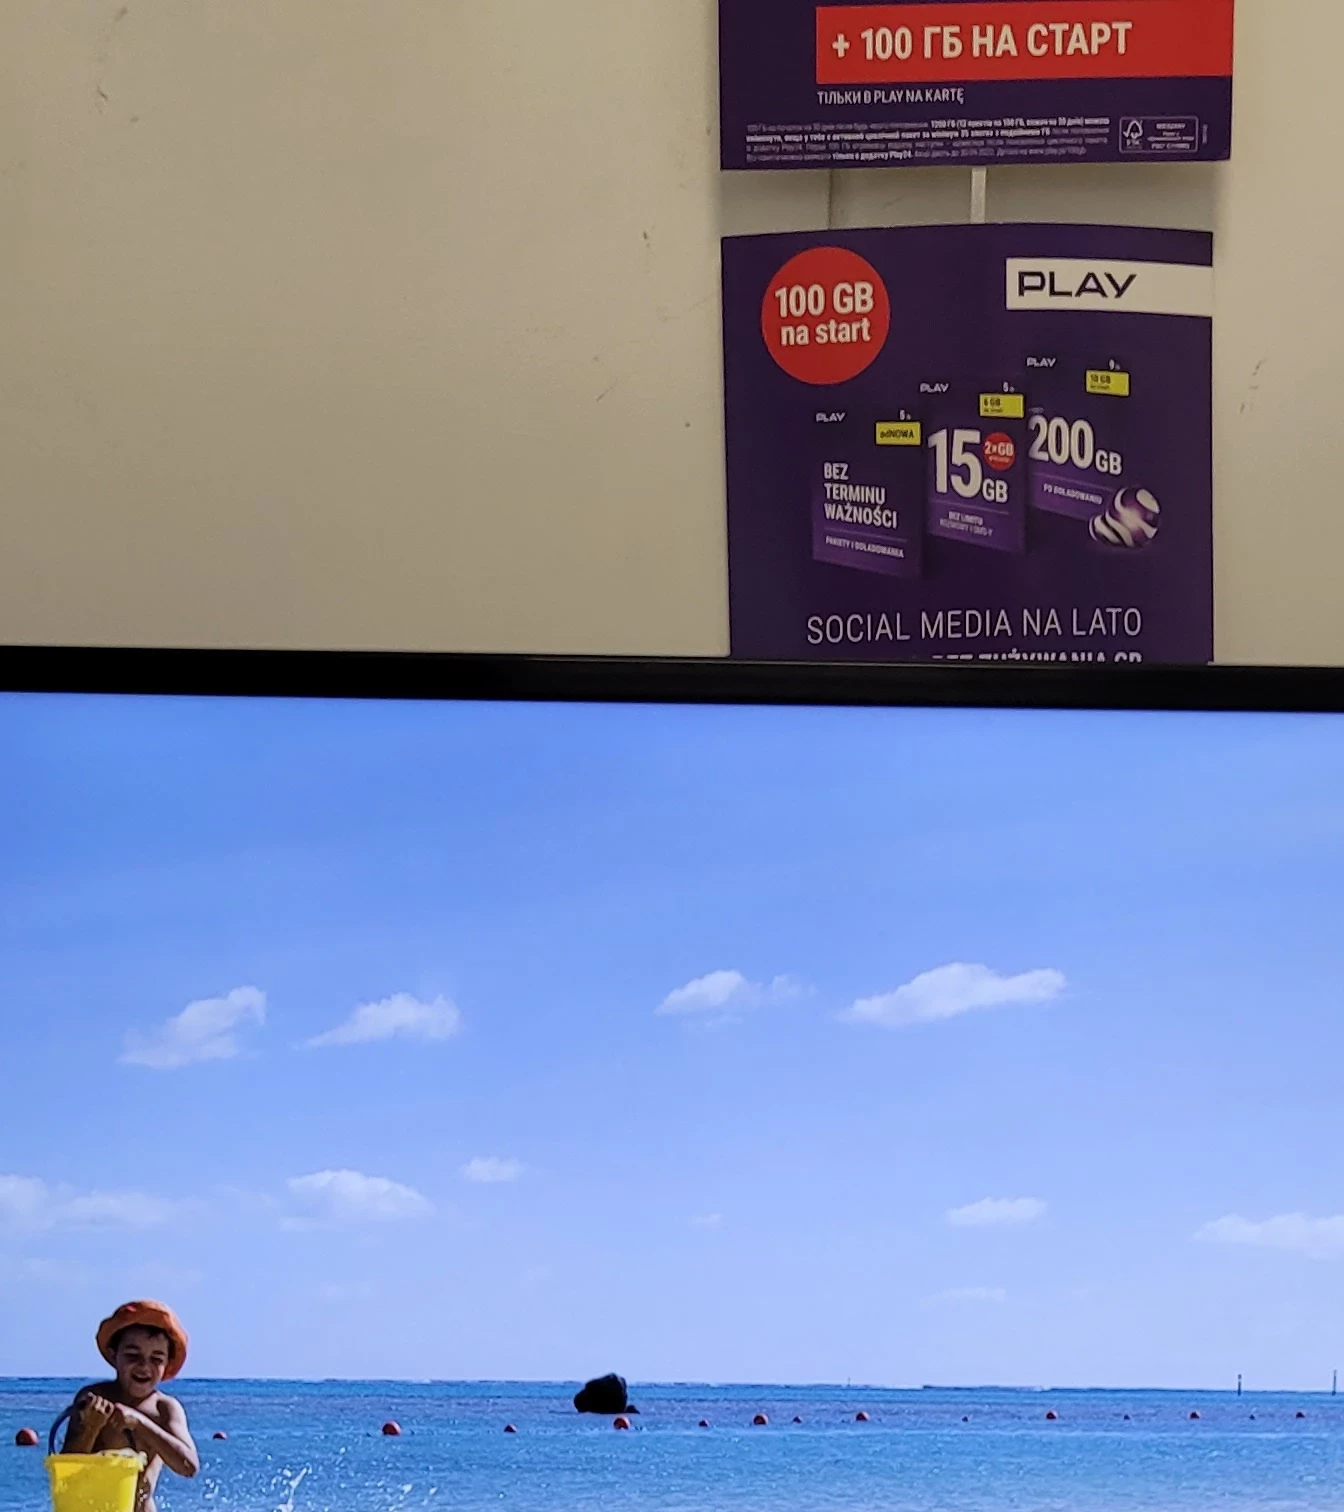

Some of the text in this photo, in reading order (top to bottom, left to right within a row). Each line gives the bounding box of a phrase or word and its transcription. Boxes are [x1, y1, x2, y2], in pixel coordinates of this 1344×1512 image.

[860, 26, 913, 60] 100
[923, 25, 963, 59] ГБ
[972, 23, 1017, 57] НА
[1027, 21, 1133, 56] СТАРТ
[873, 89, 904, 104] PLAY
[906, 88, 924, 103] NA
[925, 87, 965, 104] KARTĘ
[1017, 270, 1137, 299] PLAY
[774, 280, 874, 318] 100 GB
[780, 316, 872, 346] na start
[1027, 356, 1056, 367] PLAY
[919, 382, 949, 393] PLAY
[816, 412, 846, 422] PLAY
[1028, 414, 1123, 475] 200 GB
[823, 462, 849, 481] BEZ
[928, 428, 1008, 503] 15 GB
[823, 482, 886, 504] TERMINU
[823, 502, 898, 529] WAŻNOŚCI
[807, 607, 1142, 645] SOCIAL MEDIA NA LATO
